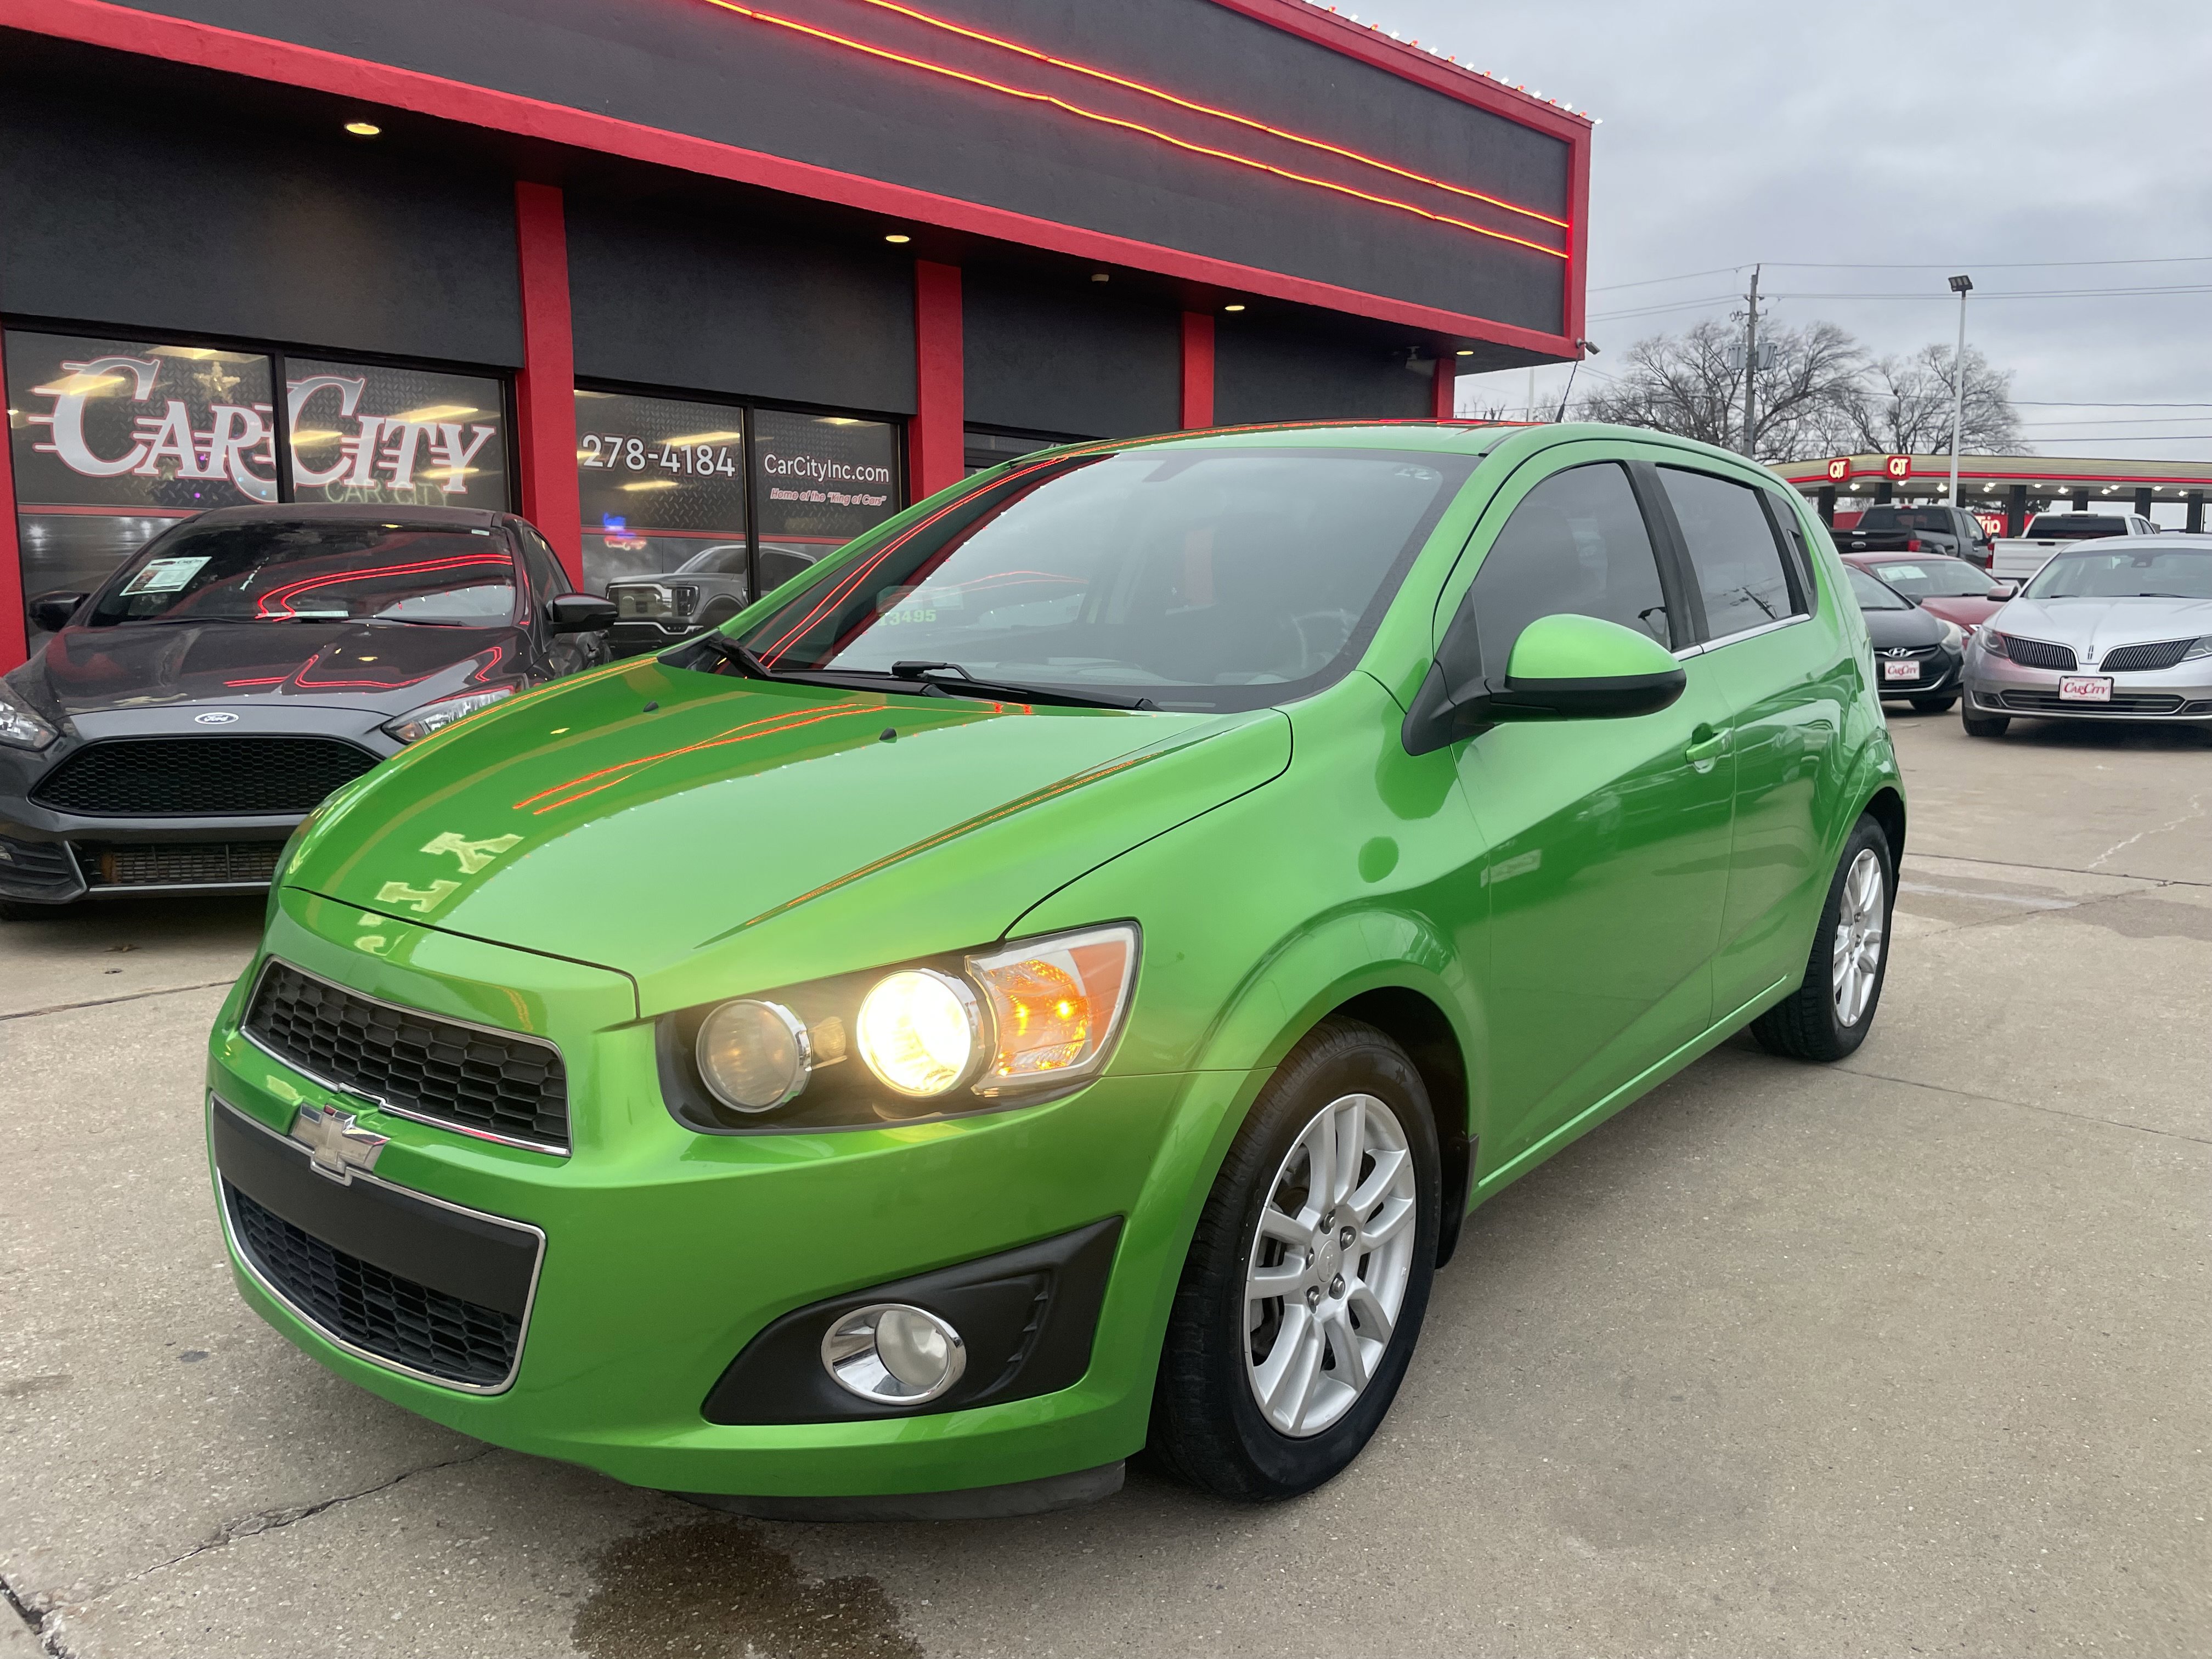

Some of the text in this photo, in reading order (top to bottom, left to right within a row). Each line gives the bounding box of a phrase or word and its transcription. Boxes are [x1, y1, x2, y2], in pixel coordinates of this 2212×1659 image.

[583, 434, 736, 477] 278-4184
[1890, 458, 1909, 476] QT
[764, 454, 889, 482] CarCityInc.com
[1830, 461, 1847, 478] QT
[325, 478, 449, 506] CAR CITY
[770, 488, 887, 506] Home of the "King of Cars"
